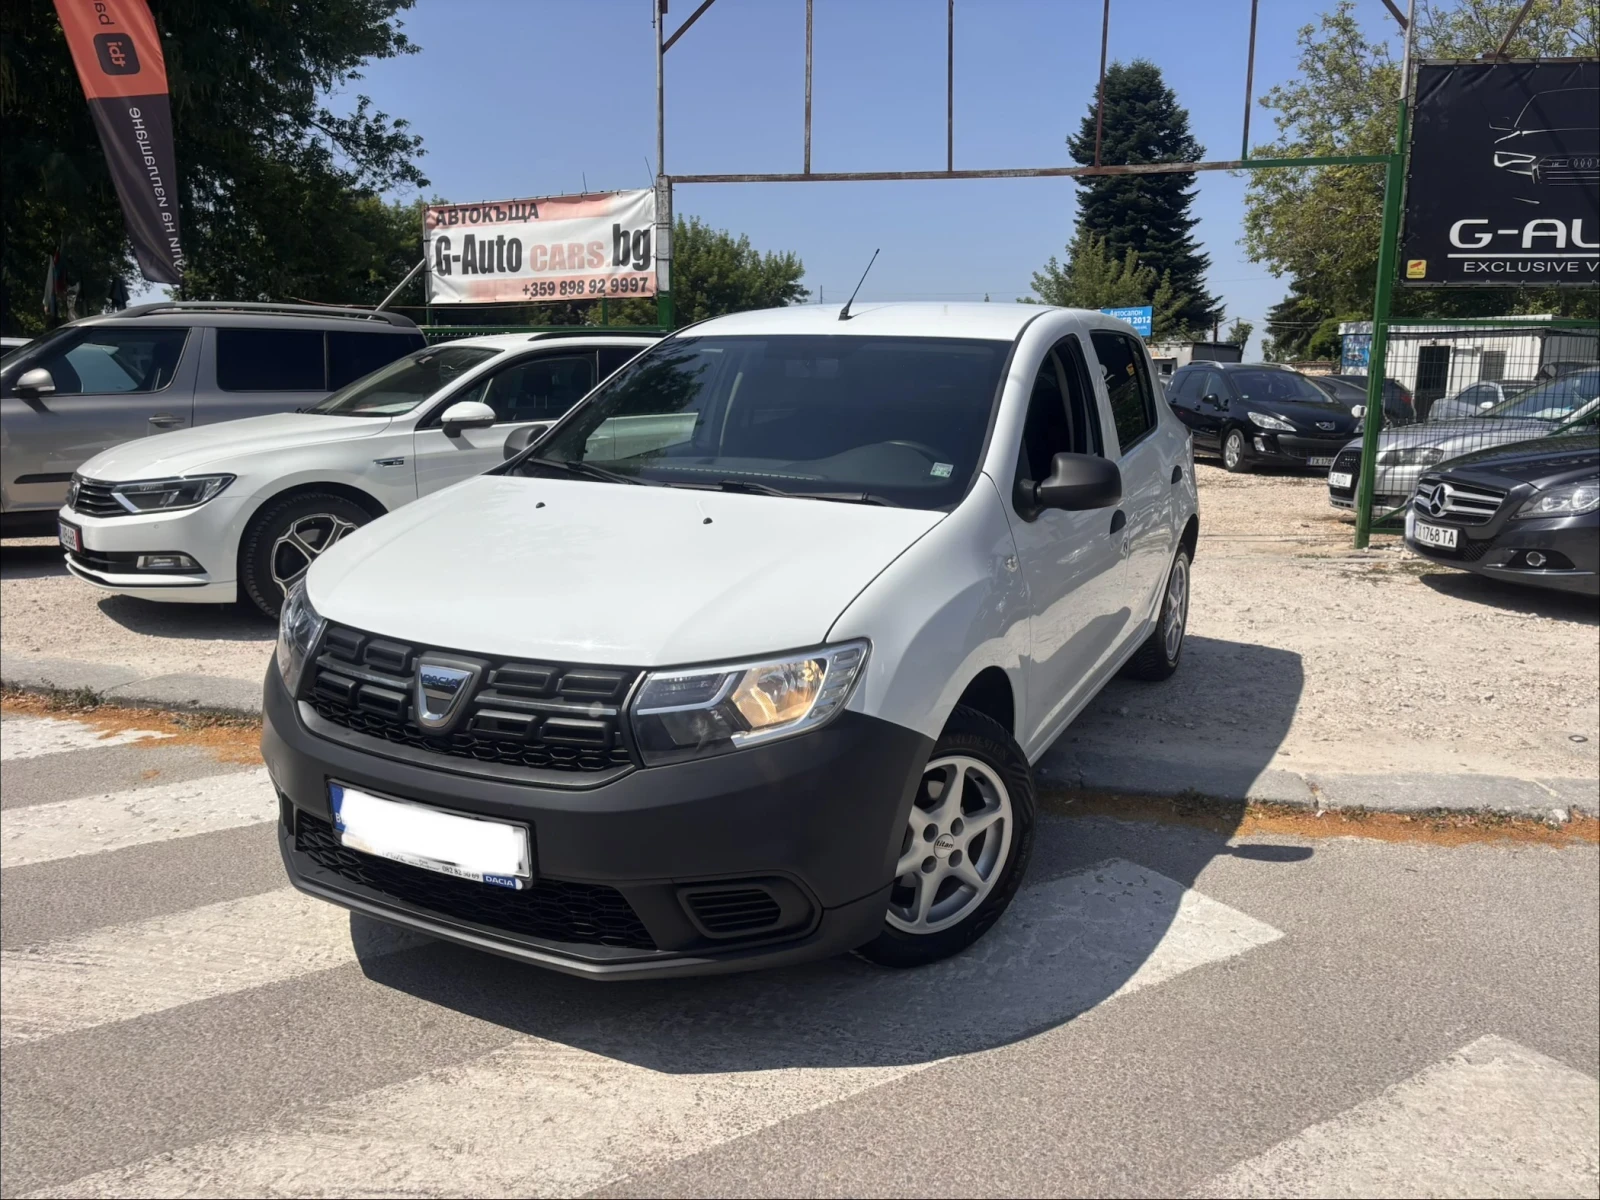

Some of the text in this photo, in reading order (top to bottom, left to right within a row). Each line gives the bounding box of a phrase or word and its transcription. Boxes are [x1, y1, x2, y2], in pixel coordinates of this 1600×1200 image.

[435, 202, 540, 227] АВТОКЪЩА
[434, 233, 523, 277] G-Auto
[1463, 261, 1580, 273] EXCLUSIVE
[522, 277, 649, 298] +359 898 92 9997
[1133, 316, 1151, 324] 2012
[423, 673, 458, 688] DACIA
[936, 839, 954, 849] titan
[485, 875, 514, 887] DACIA
